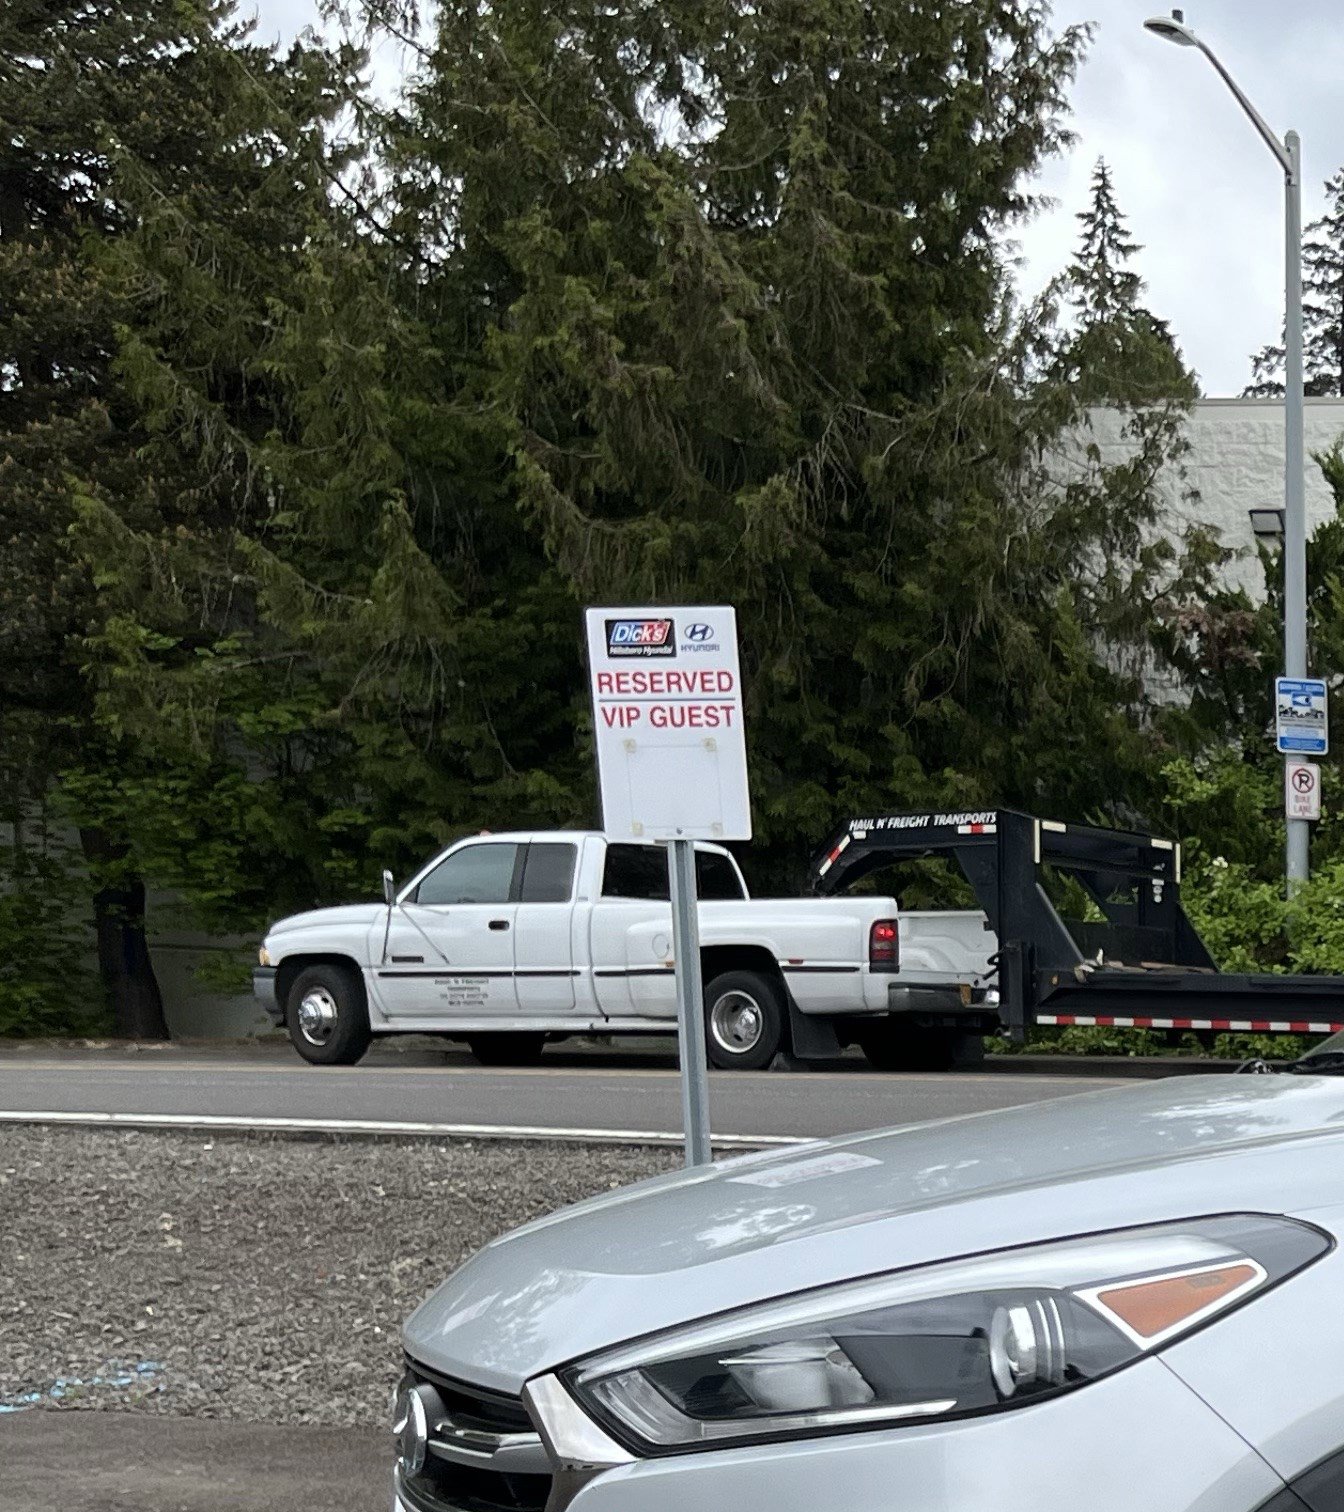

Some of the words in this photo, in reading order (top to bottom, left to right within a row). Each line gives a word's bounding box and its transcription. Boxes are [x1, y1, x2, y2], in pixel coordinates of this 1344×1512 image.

[597, 671, 734, 694] RESERVED
[601, 707, 641, 728] VIP
[650, 706, 736, 728] GUEST
[849, 819, 875, 831] HAUL
[887, 815, 931, 829] FREIGHT
[933, 811, 997, 826] TRANSPORTS
